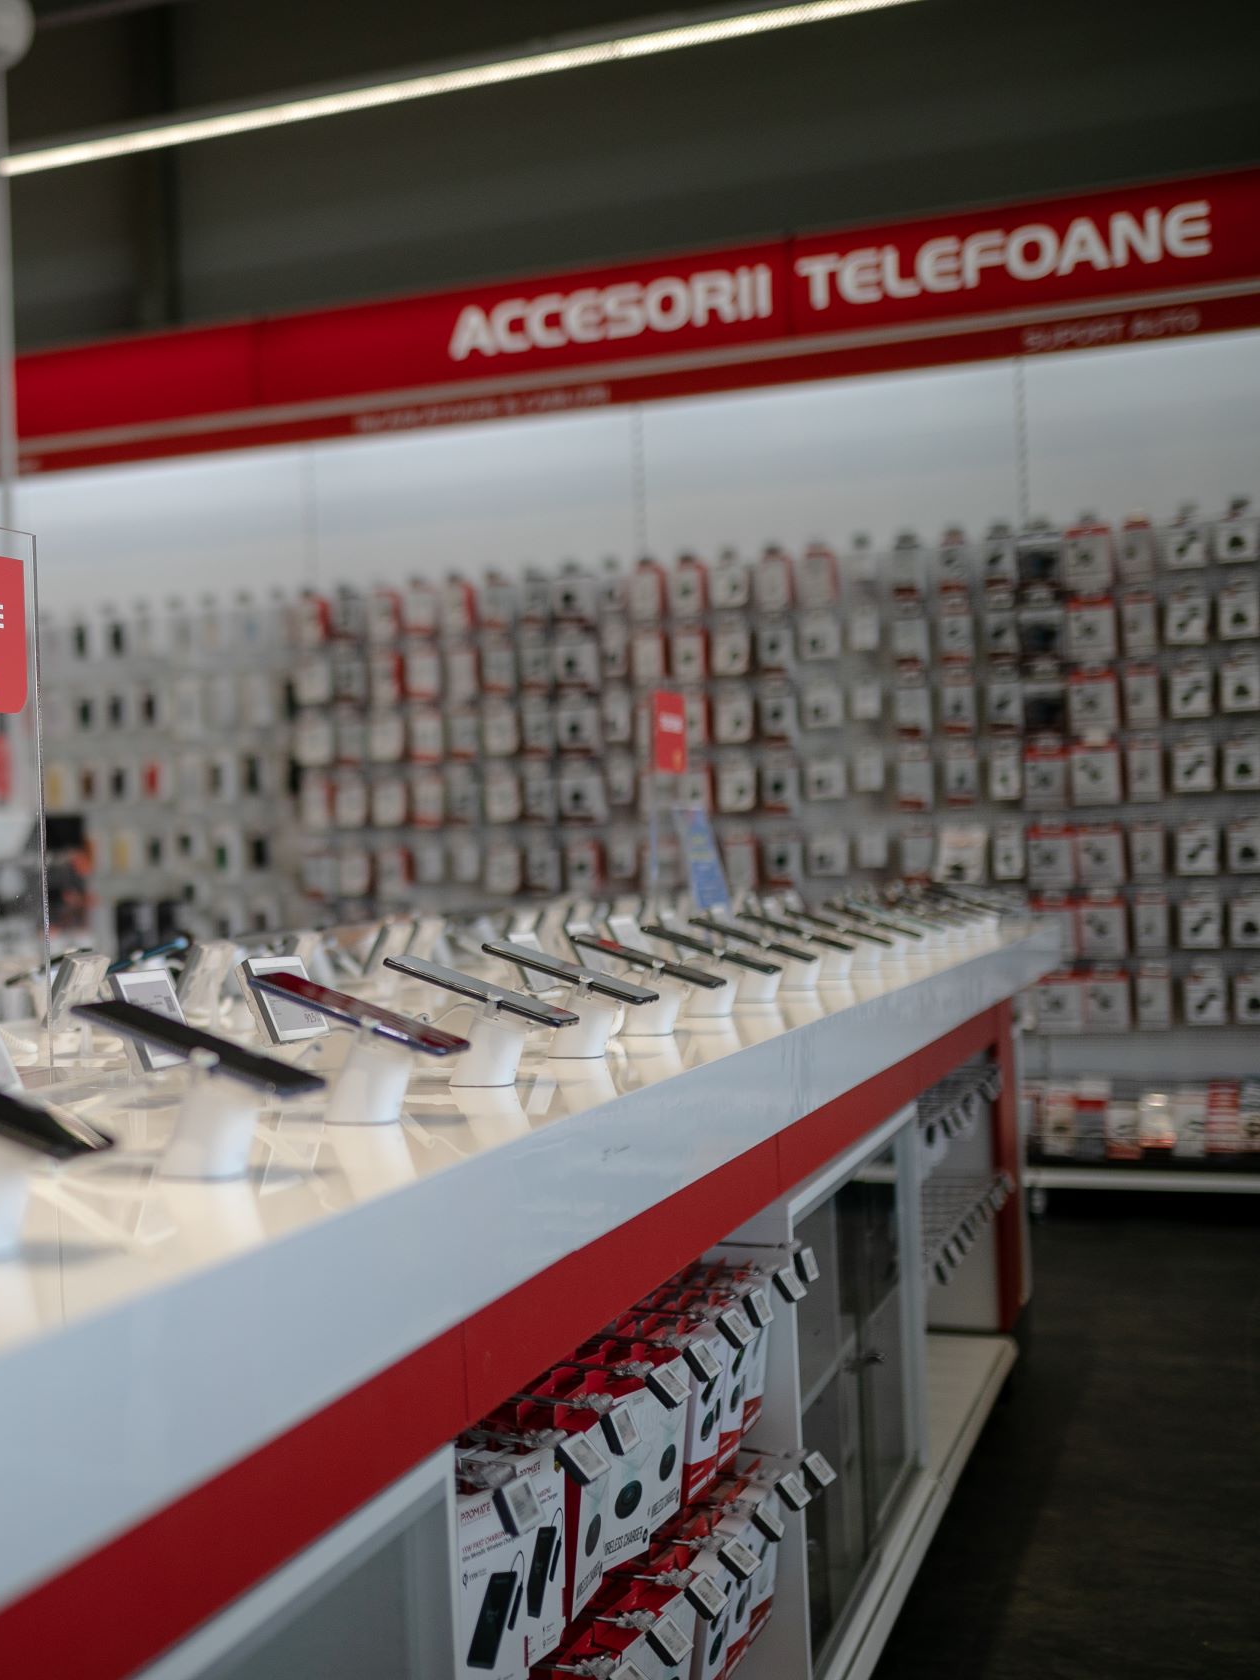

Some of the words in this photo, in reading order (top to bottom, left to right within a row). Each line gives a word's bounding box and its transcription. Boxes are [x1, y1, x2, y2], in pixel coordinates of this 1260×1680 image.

[448, 264, 773, 361] ACCESORII
[795, 201, 1212, 311] TELEFOANE
[460, 1502, 491, 1521] PROMATE
